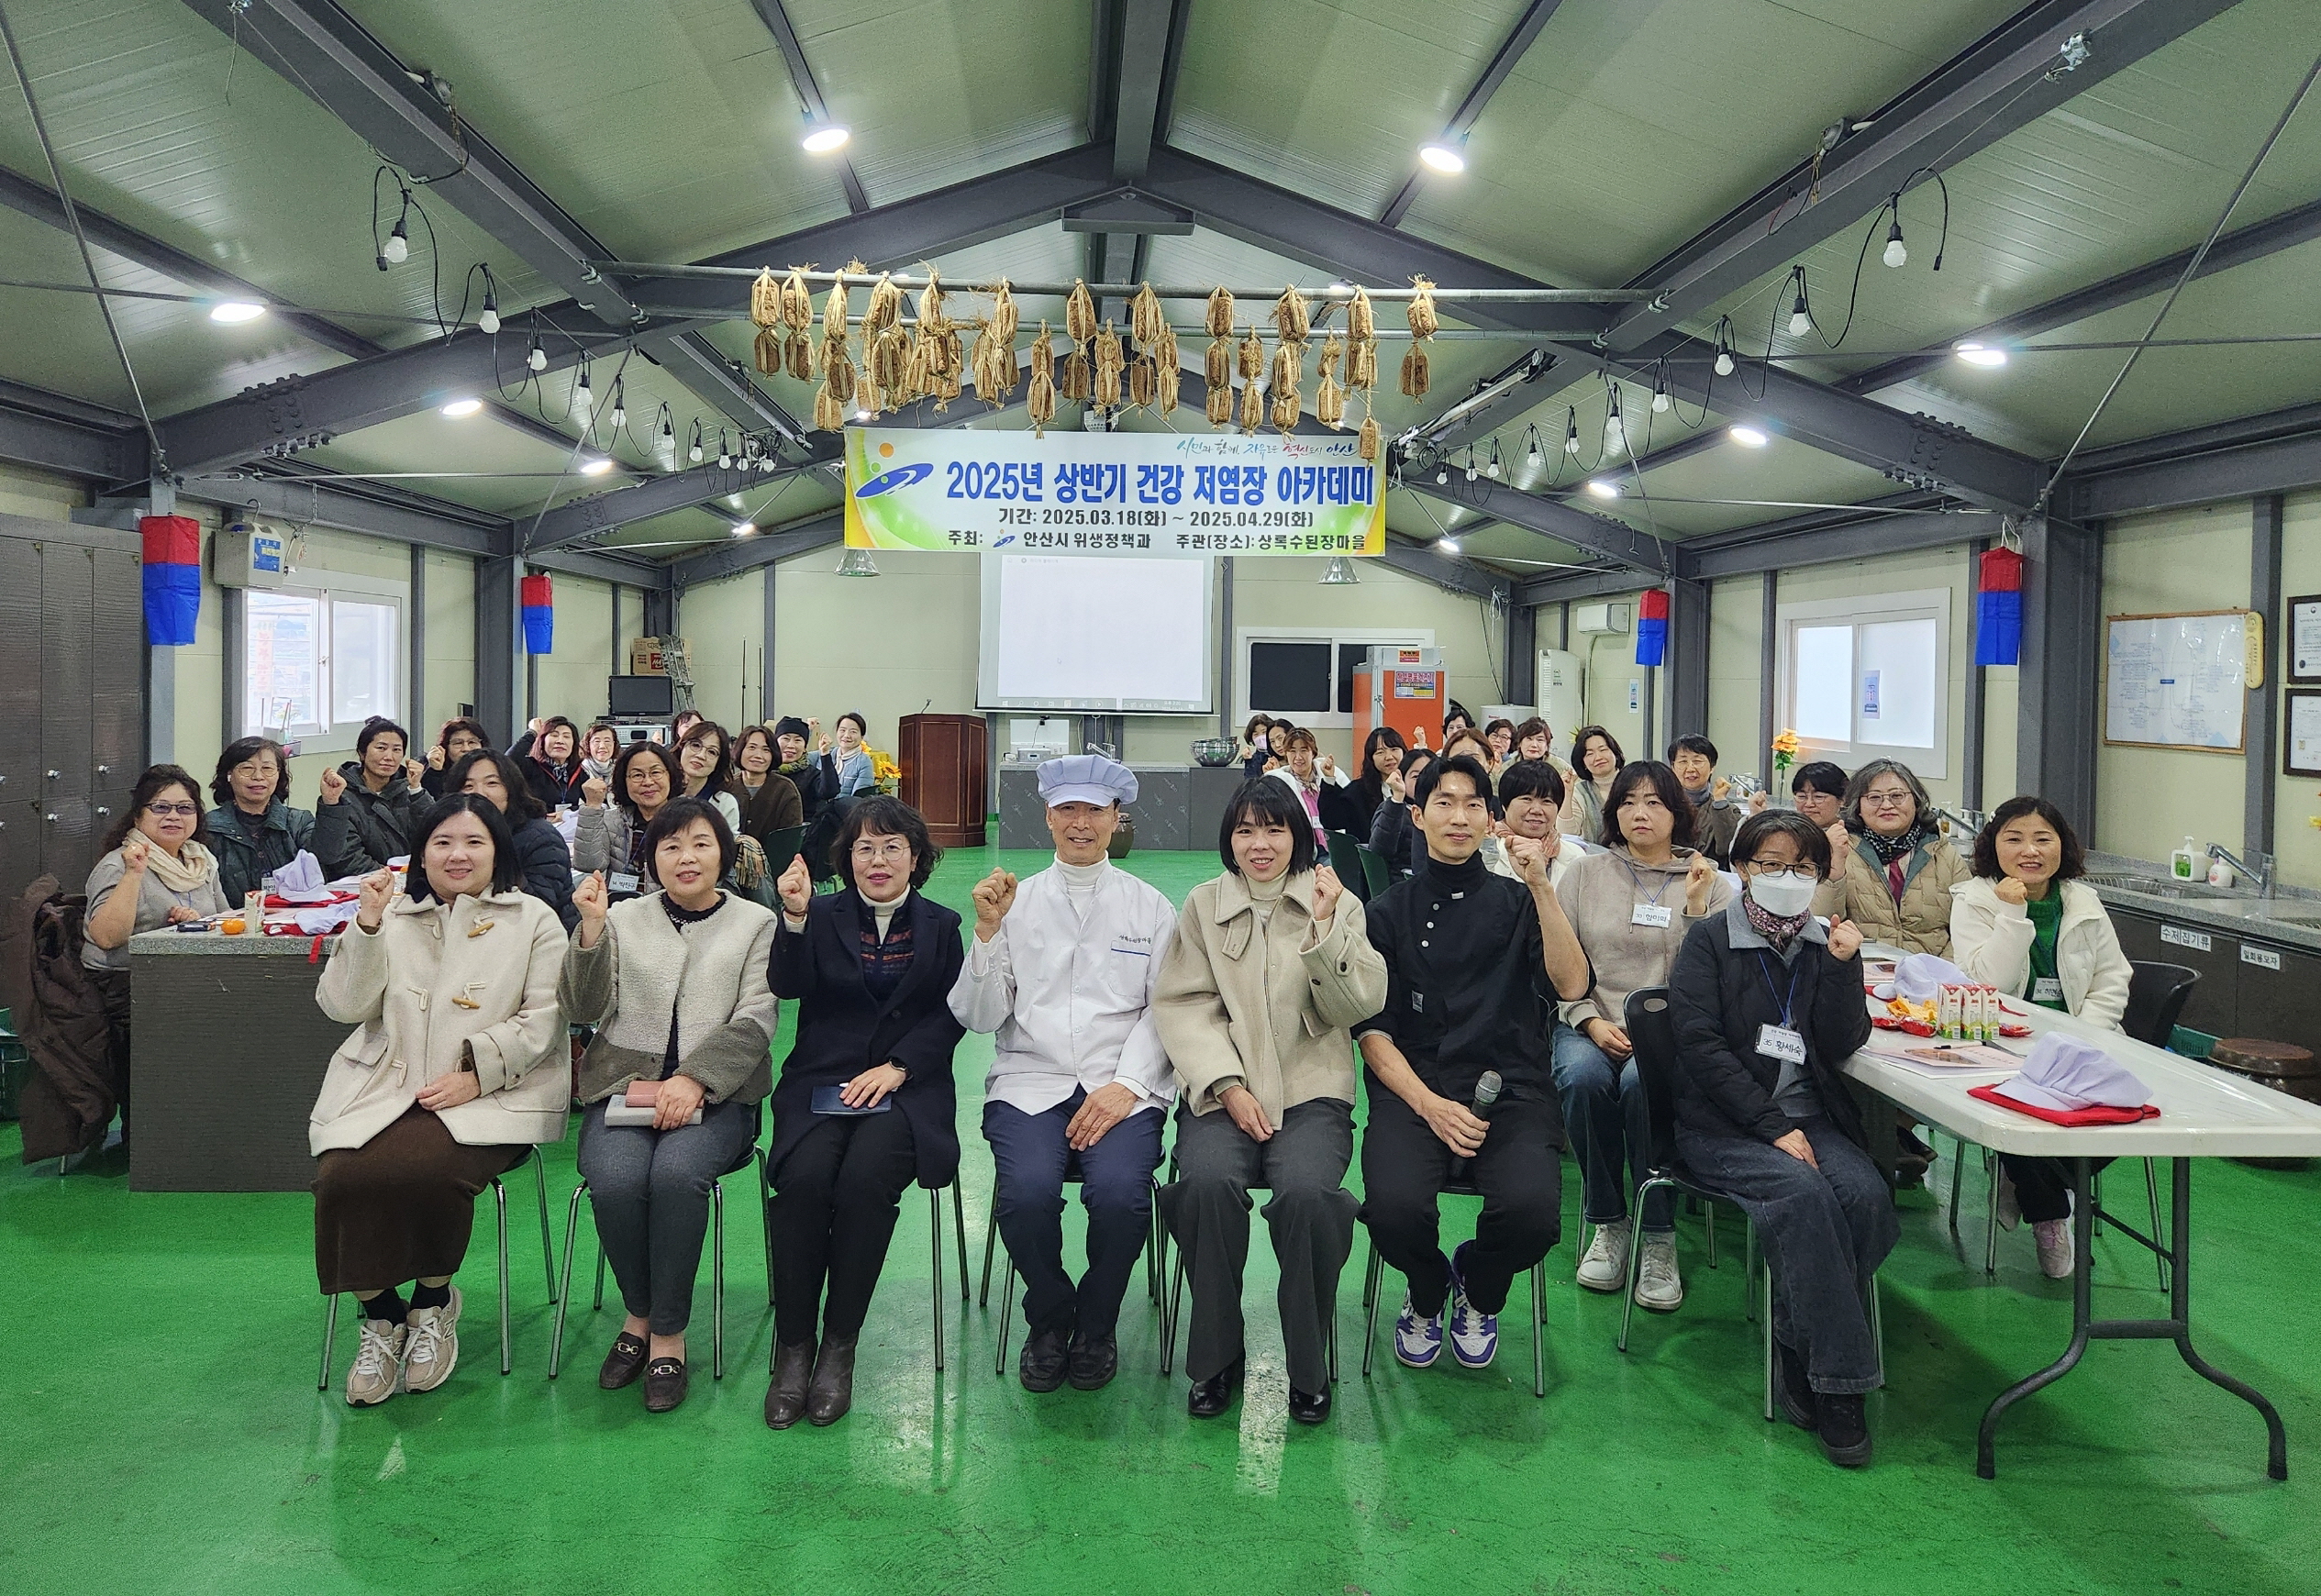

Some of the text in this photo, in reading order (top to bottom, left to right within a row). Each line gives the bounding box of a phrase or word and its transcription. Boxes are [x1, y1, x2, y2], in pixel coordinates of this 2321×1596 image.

[1283, 442, 1323, 460] 혁신도시
[1326, 442, 1358, 457] 안산
[947, 461, 1373, 505] 2025년 상반기 건강 저염장 아카데미
[998, 508, 1038, 525] 기간:
[948, 530, 983, 547] 주최:
[1023, 532, 1069, 548] 안산시
[1073, 533, 1150, 549] 위생정책과
[1258, 535, 1365, 550] 상록수된장마을
[1762, 1037, 1773, 1047] 35
